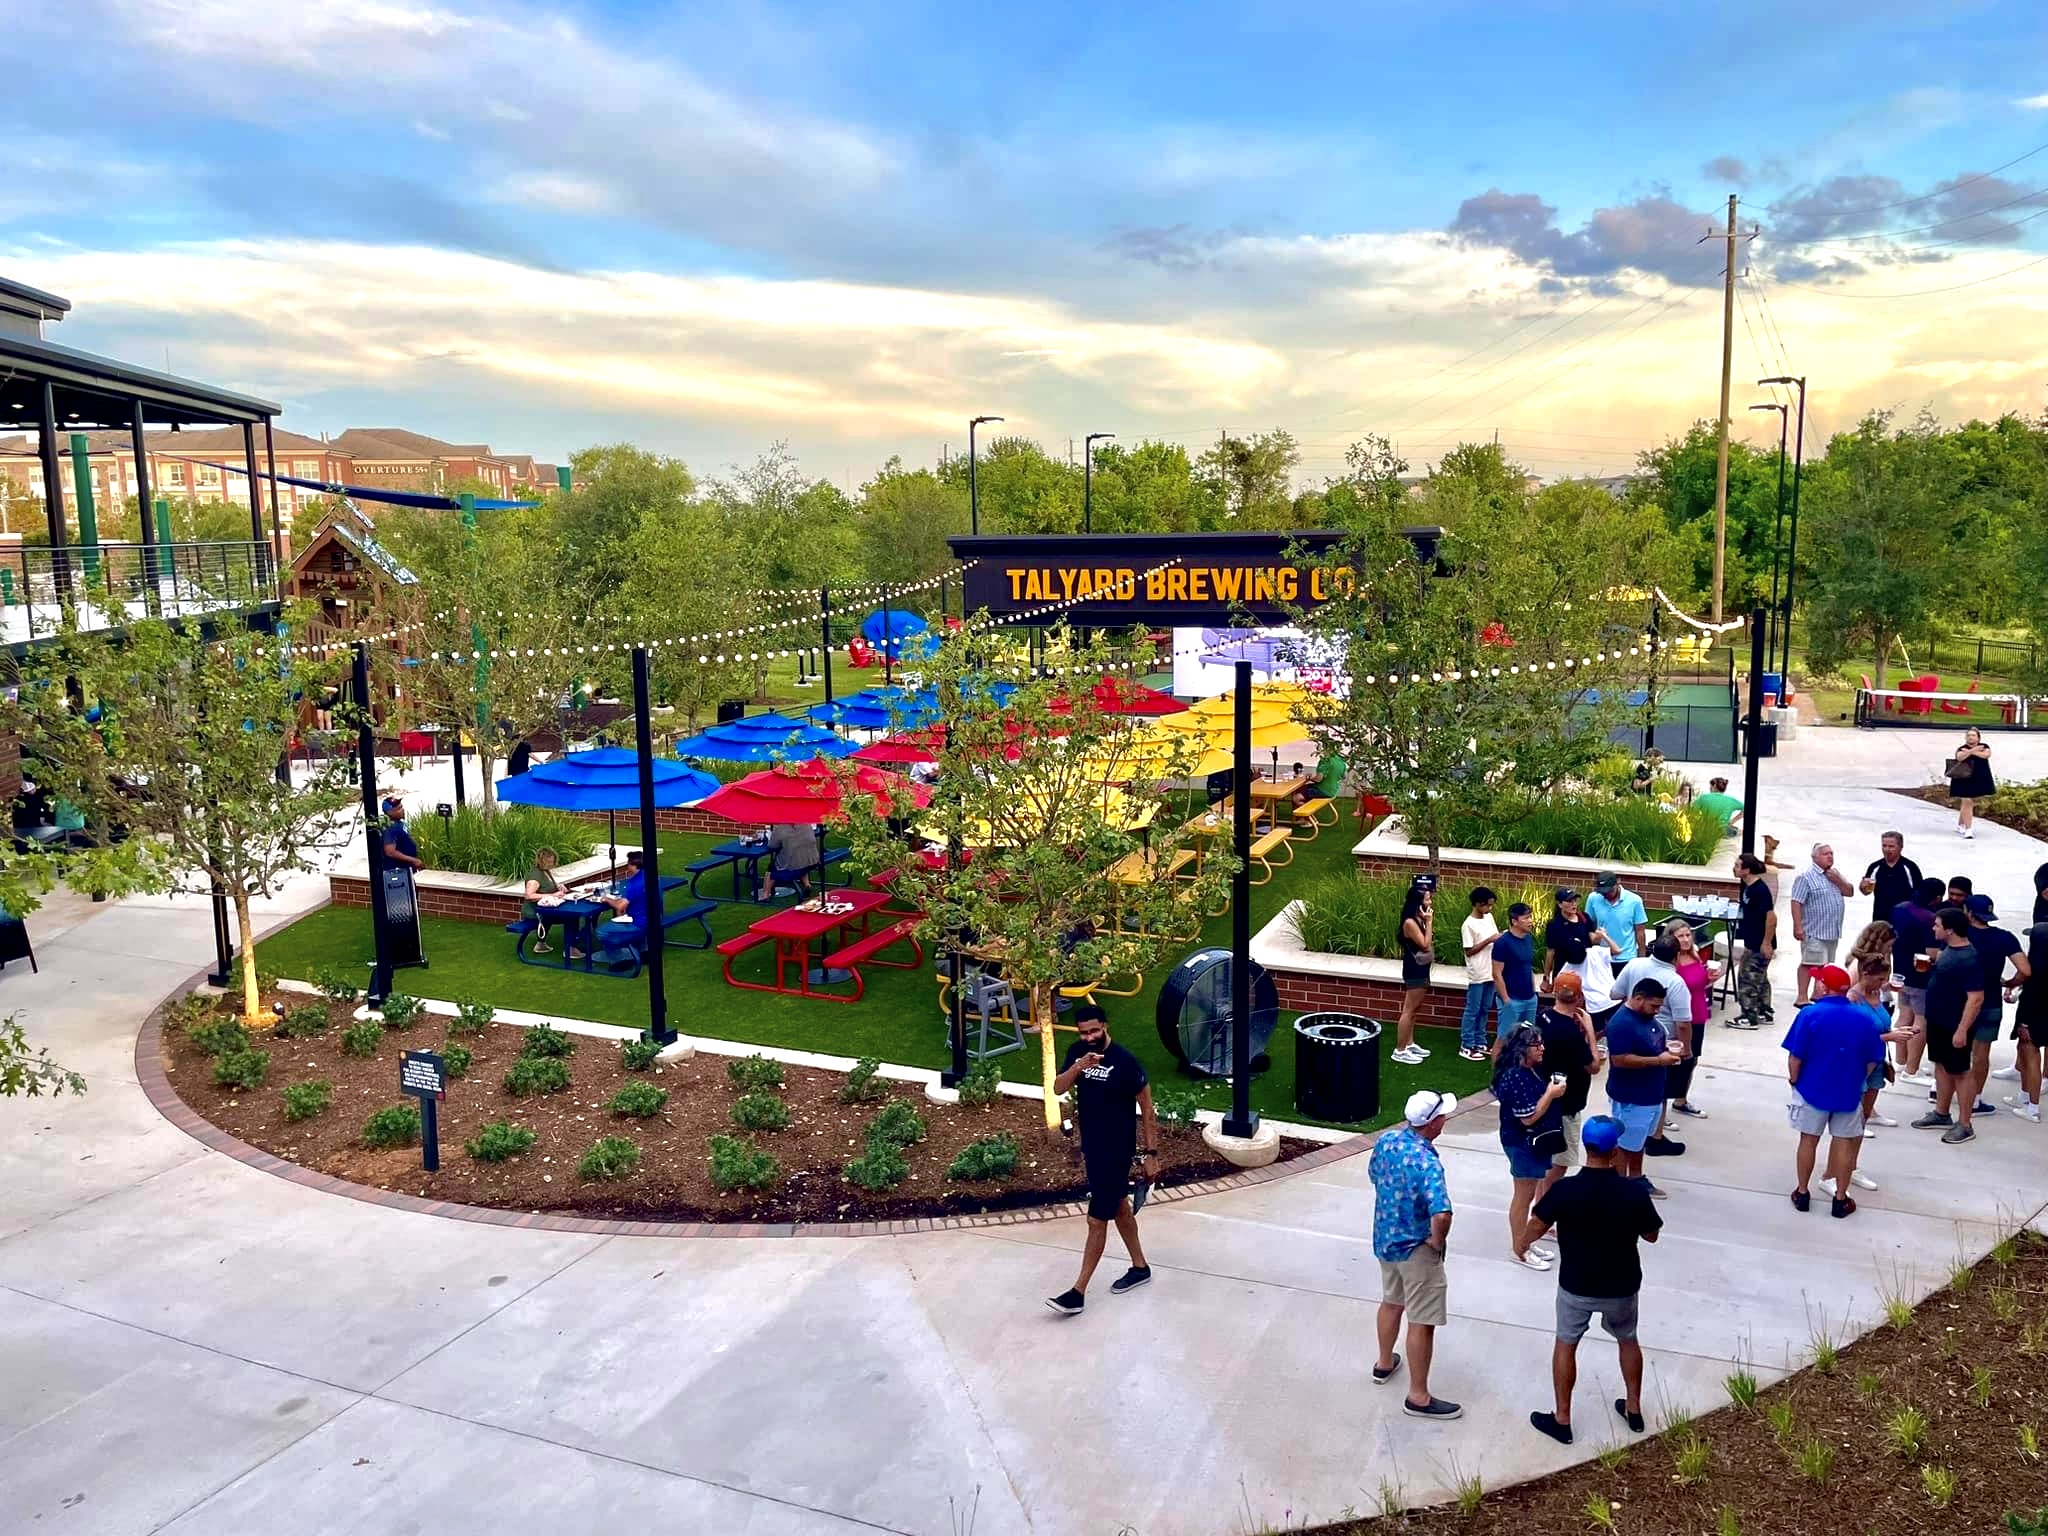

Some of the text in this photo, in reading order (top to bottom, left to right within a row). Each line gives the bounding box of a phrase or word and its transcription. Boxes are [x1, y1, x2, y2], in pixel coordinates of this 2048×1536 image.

[354, 466, 413, 474] OVERTURE
[1006, 568, 1135, 600] TALYARD
[1147, 567, 1298, 600] BREWING
